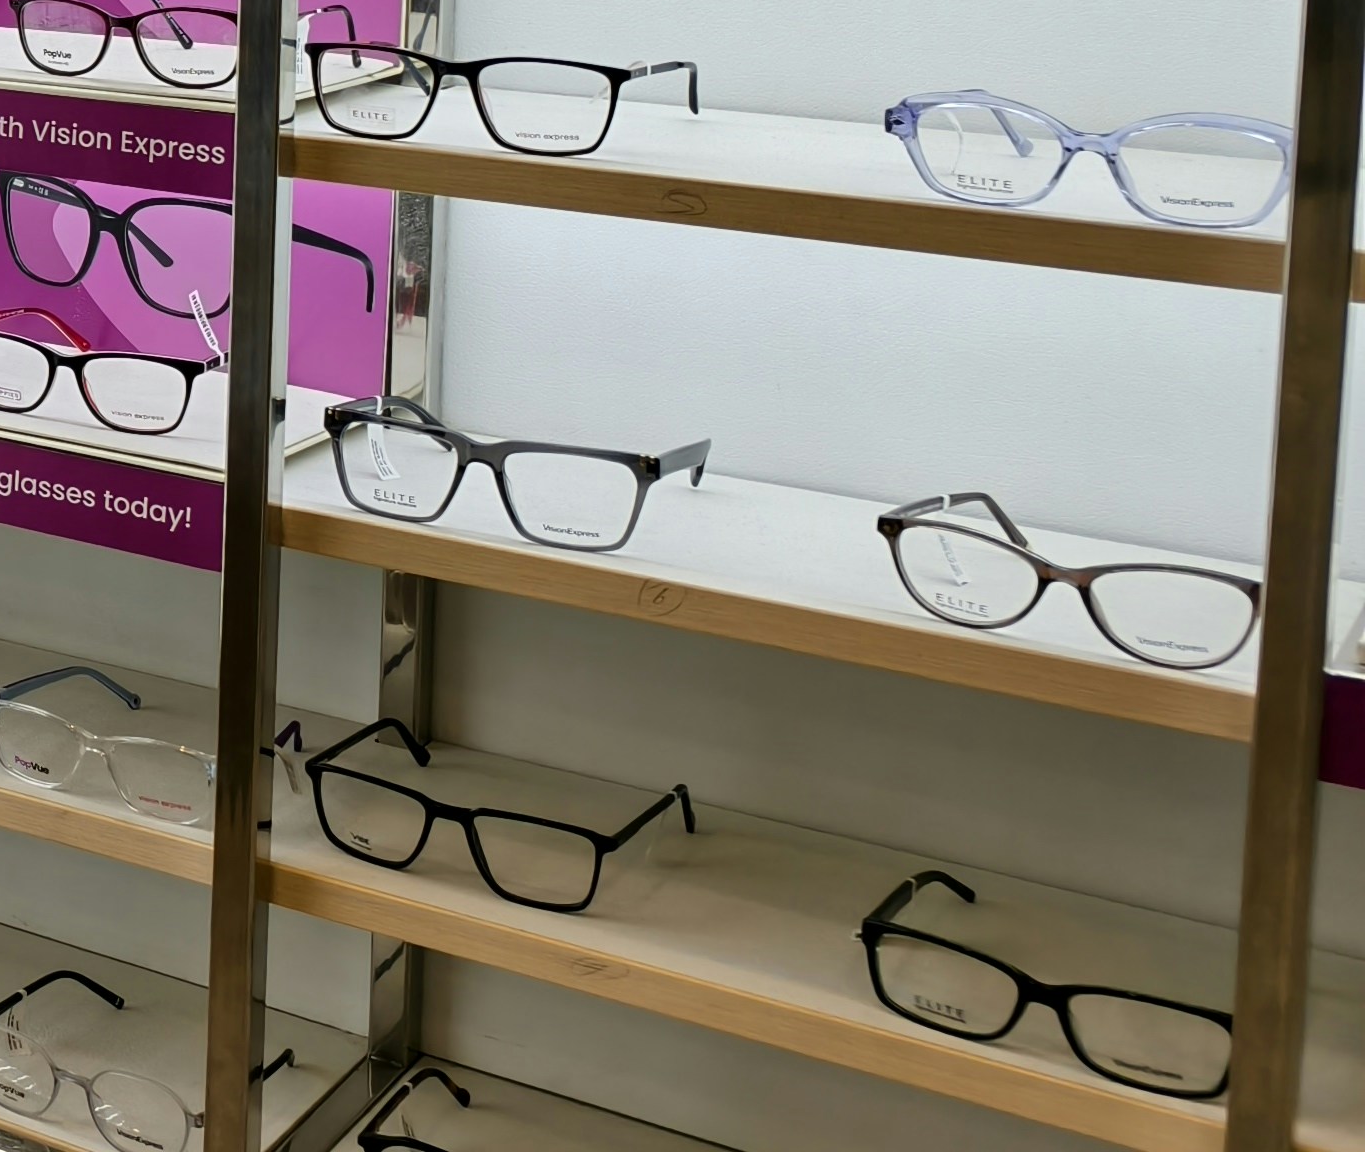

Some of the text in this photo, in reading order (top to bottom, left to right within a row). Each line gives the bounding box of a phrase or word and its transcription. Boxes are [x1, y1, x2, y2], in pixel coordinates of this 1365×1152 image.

[44, 49, 71, 59] PopVue
[171, 67, 215, 76] VisionExpress
[352, 110, 389, 121] ELITE
[32, 119, 112, 150] Vision
[121, 131, 226, 164] Express
[957, 174, 1012, 189] ELITE
[374, 488, 415, 504] ELITE
[104, 489, 191, 532] today!
[543, 523, 599, 538] VisionExpress
[936, 593, 988, 613] ELITE
[15, 756, 49, 774] PopVue
